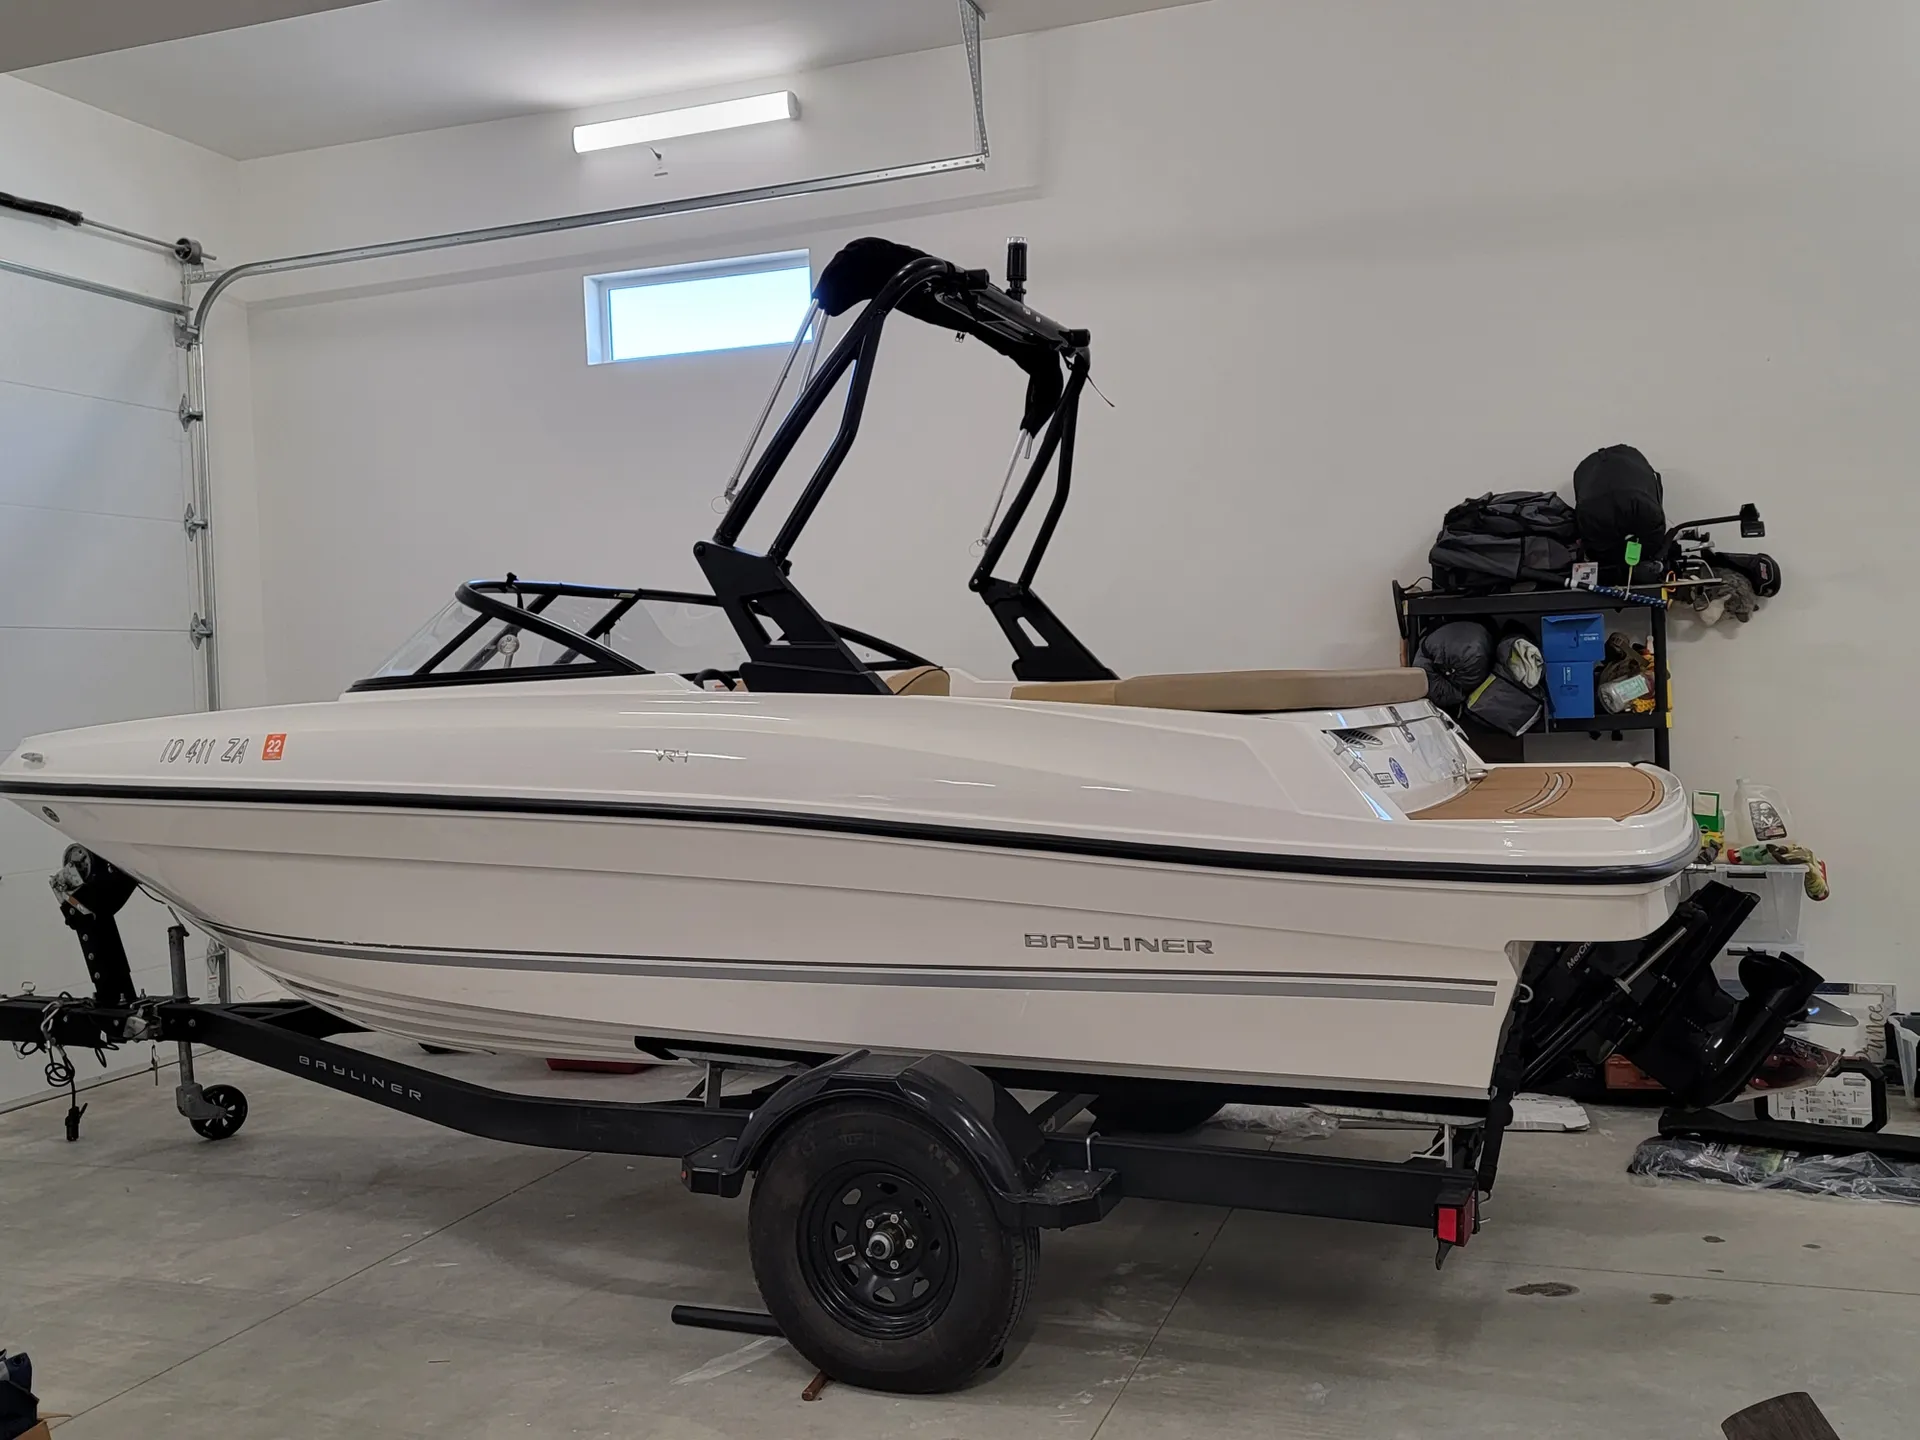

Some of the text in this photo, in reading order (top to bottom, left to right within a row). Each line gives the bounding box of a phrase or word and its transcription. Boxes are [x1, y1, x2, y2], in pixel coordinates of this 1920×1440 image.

[185, 738, 216, 764] 411
[220, 737, 249, 764] ZA
[266, 739, 281, 753] 22
[655, 748, 689, 763] VR4
[1024, 933, 1214, 954] BAYLINER
[299, 1055, 422, 1101] BAYLINER
